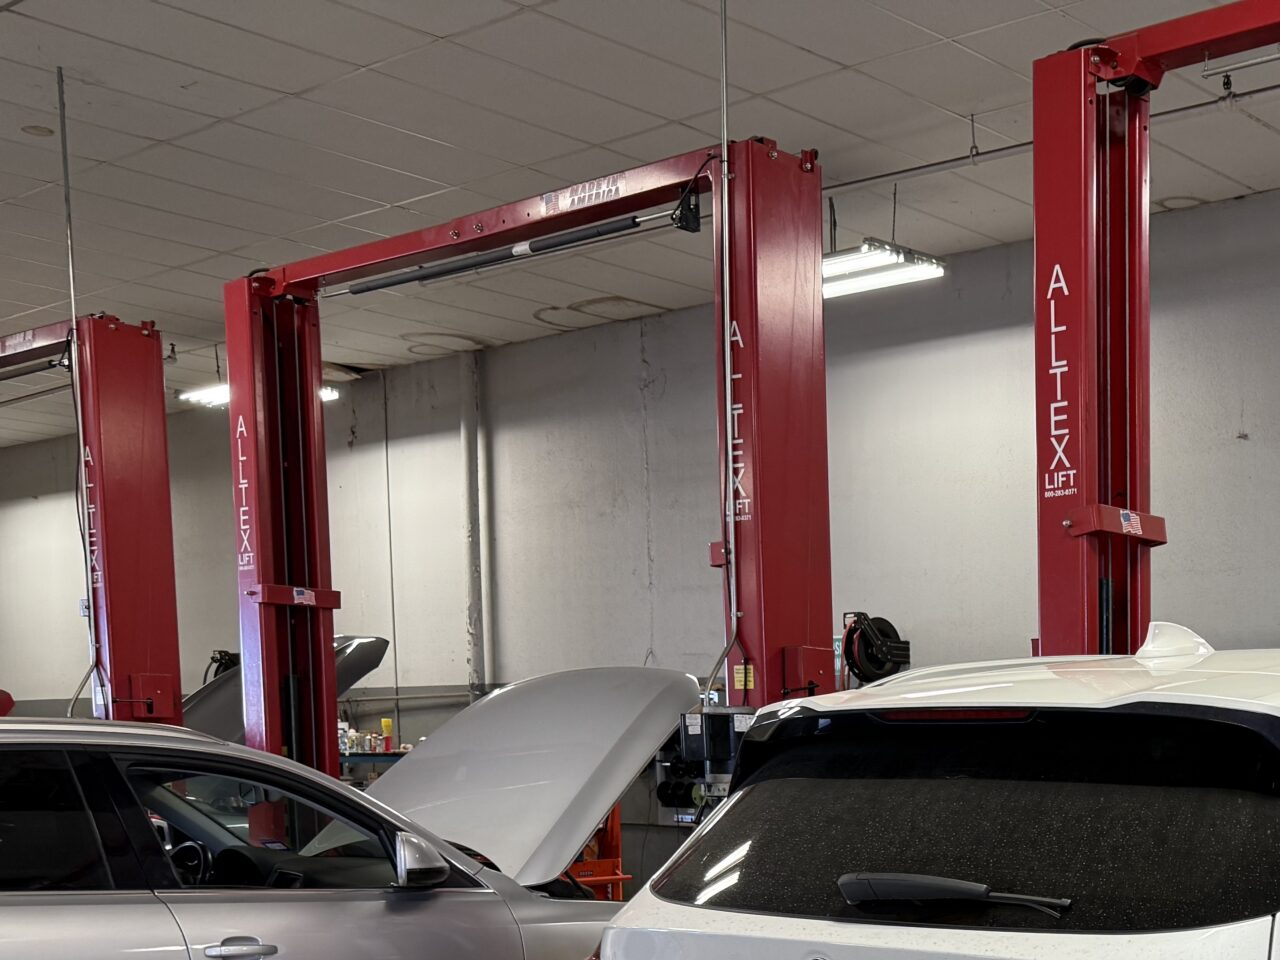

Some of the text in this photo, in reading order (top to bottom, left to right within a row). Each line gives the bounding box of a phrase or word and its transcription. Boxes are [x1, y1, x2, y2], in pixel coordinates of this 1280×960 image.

[1047, 264, 1071, 470] ALLTEX
[236, 415, 251, 552] ALLTEX
[1045, 470, 1077, 489] LIFT
